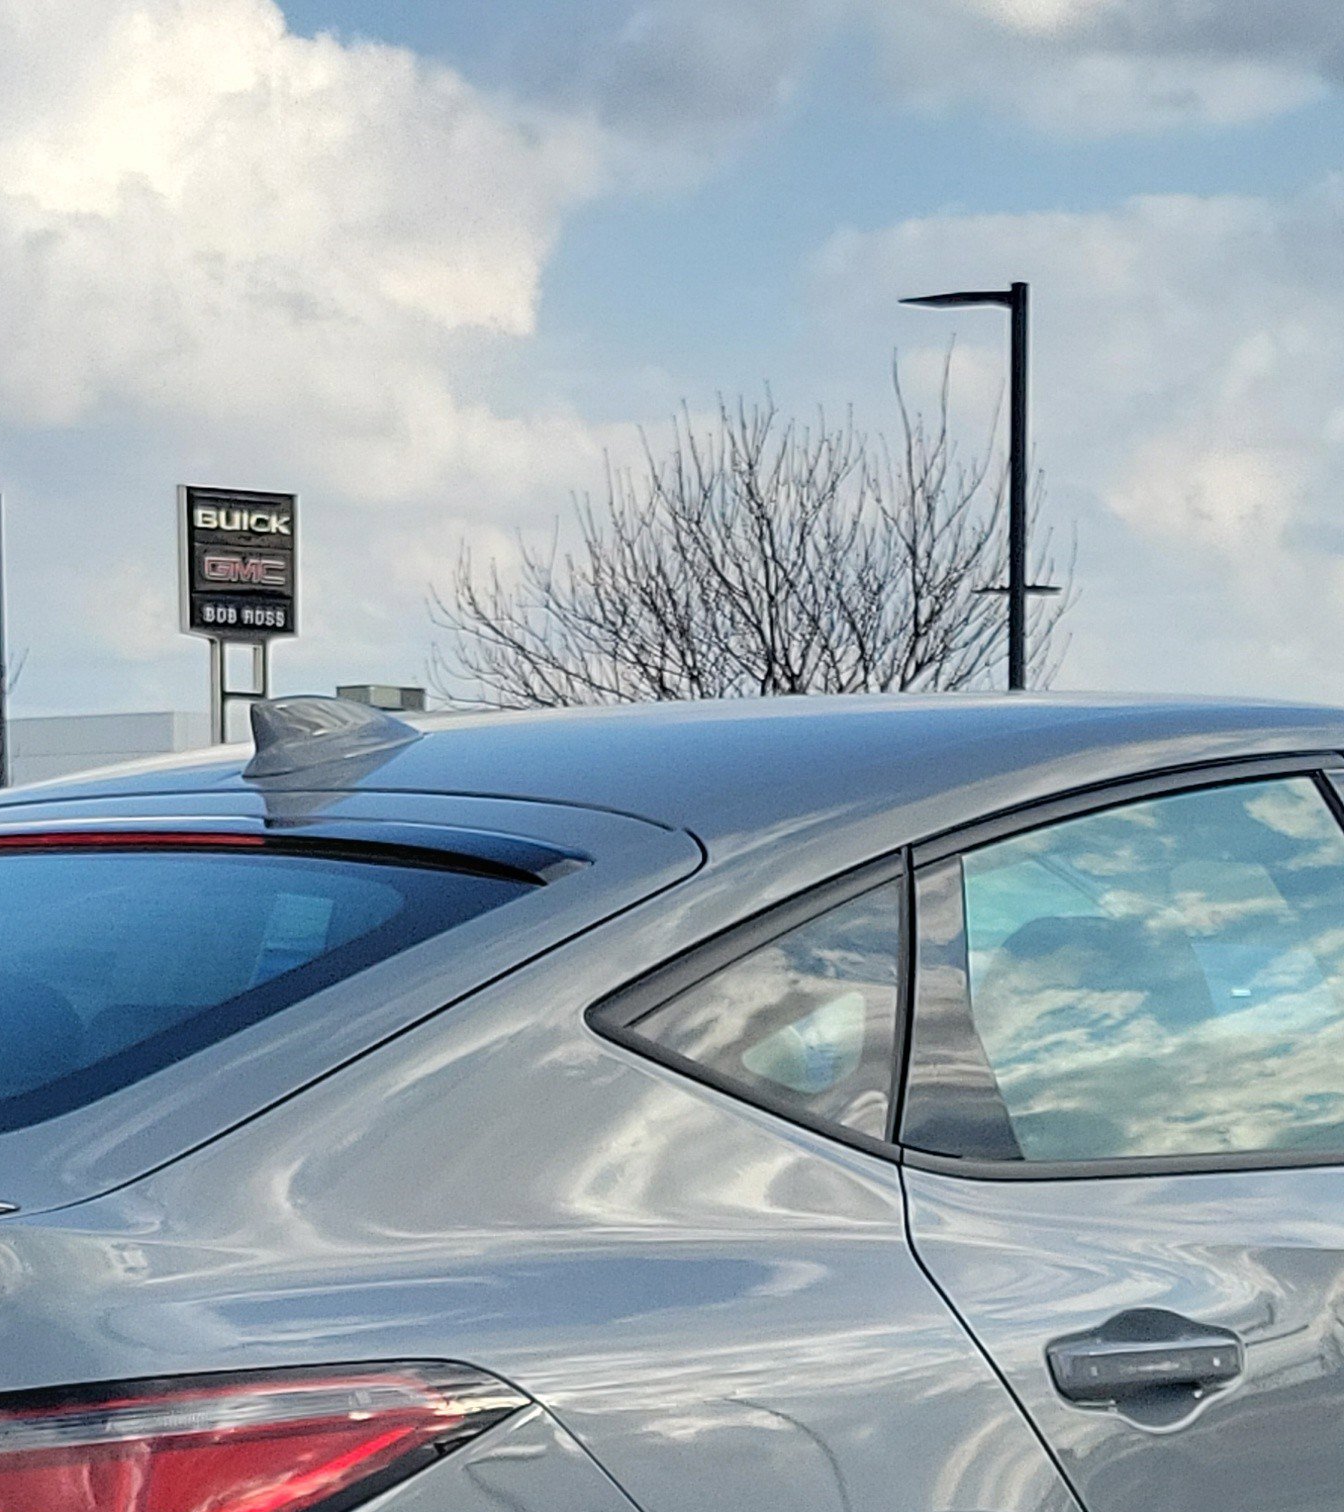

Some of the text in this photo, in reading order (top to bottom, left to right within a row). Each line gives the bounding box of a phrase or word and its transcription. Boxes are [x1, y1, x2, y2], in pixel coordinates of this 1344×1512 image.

[194, 508, 291, 535] BUICK
[205, 556, 286, 585] GMC
[204, 606, 285, 627] BOB ROSS
